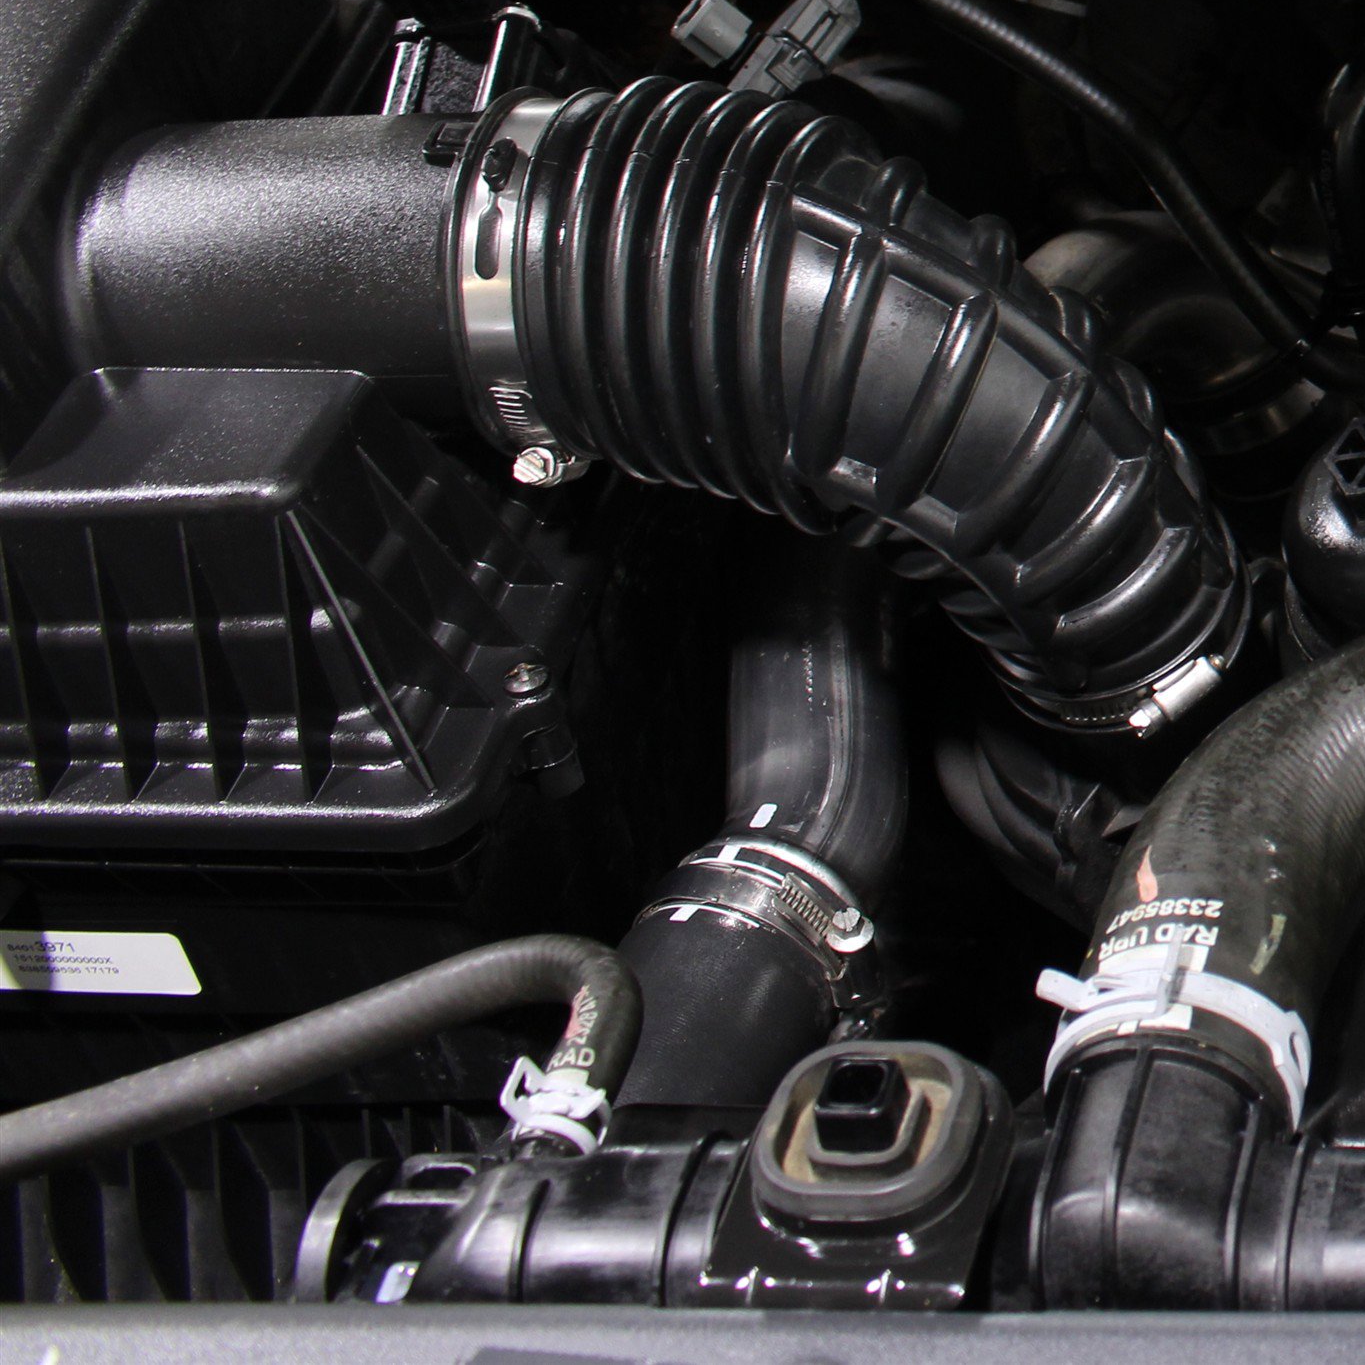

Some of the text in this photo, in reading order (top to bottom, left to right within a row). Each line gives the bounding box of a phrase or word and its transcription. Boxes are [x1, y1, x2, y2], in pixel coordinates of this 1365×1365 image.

[1106, 897, 1224, 935] 23385947
[1154, 922, 1219, 947] RAD
[545, 1047, 596, 1073] RAD
